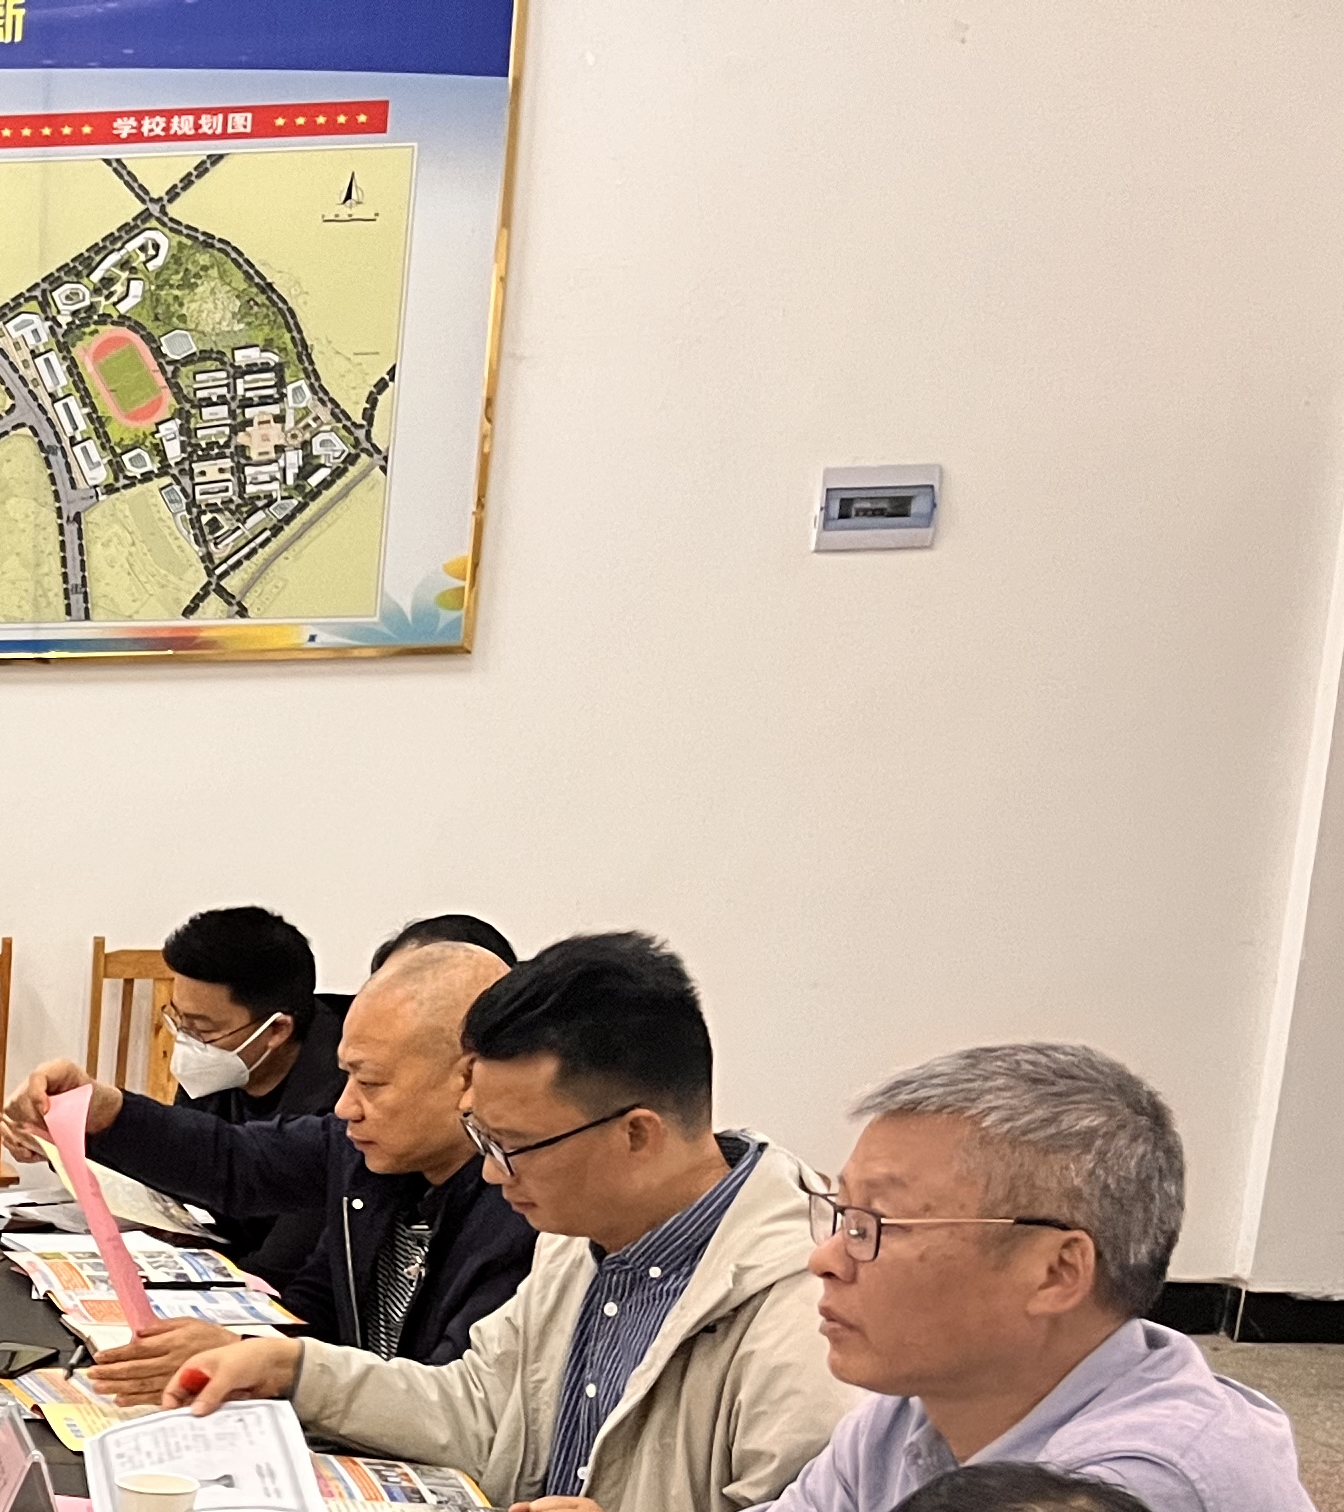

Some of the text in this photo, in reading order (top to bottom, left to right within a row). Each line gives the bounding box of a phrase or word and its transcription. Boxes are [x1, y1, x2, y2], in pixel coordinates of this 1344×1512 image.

[112, 112, 253, 139] 学校规划图
